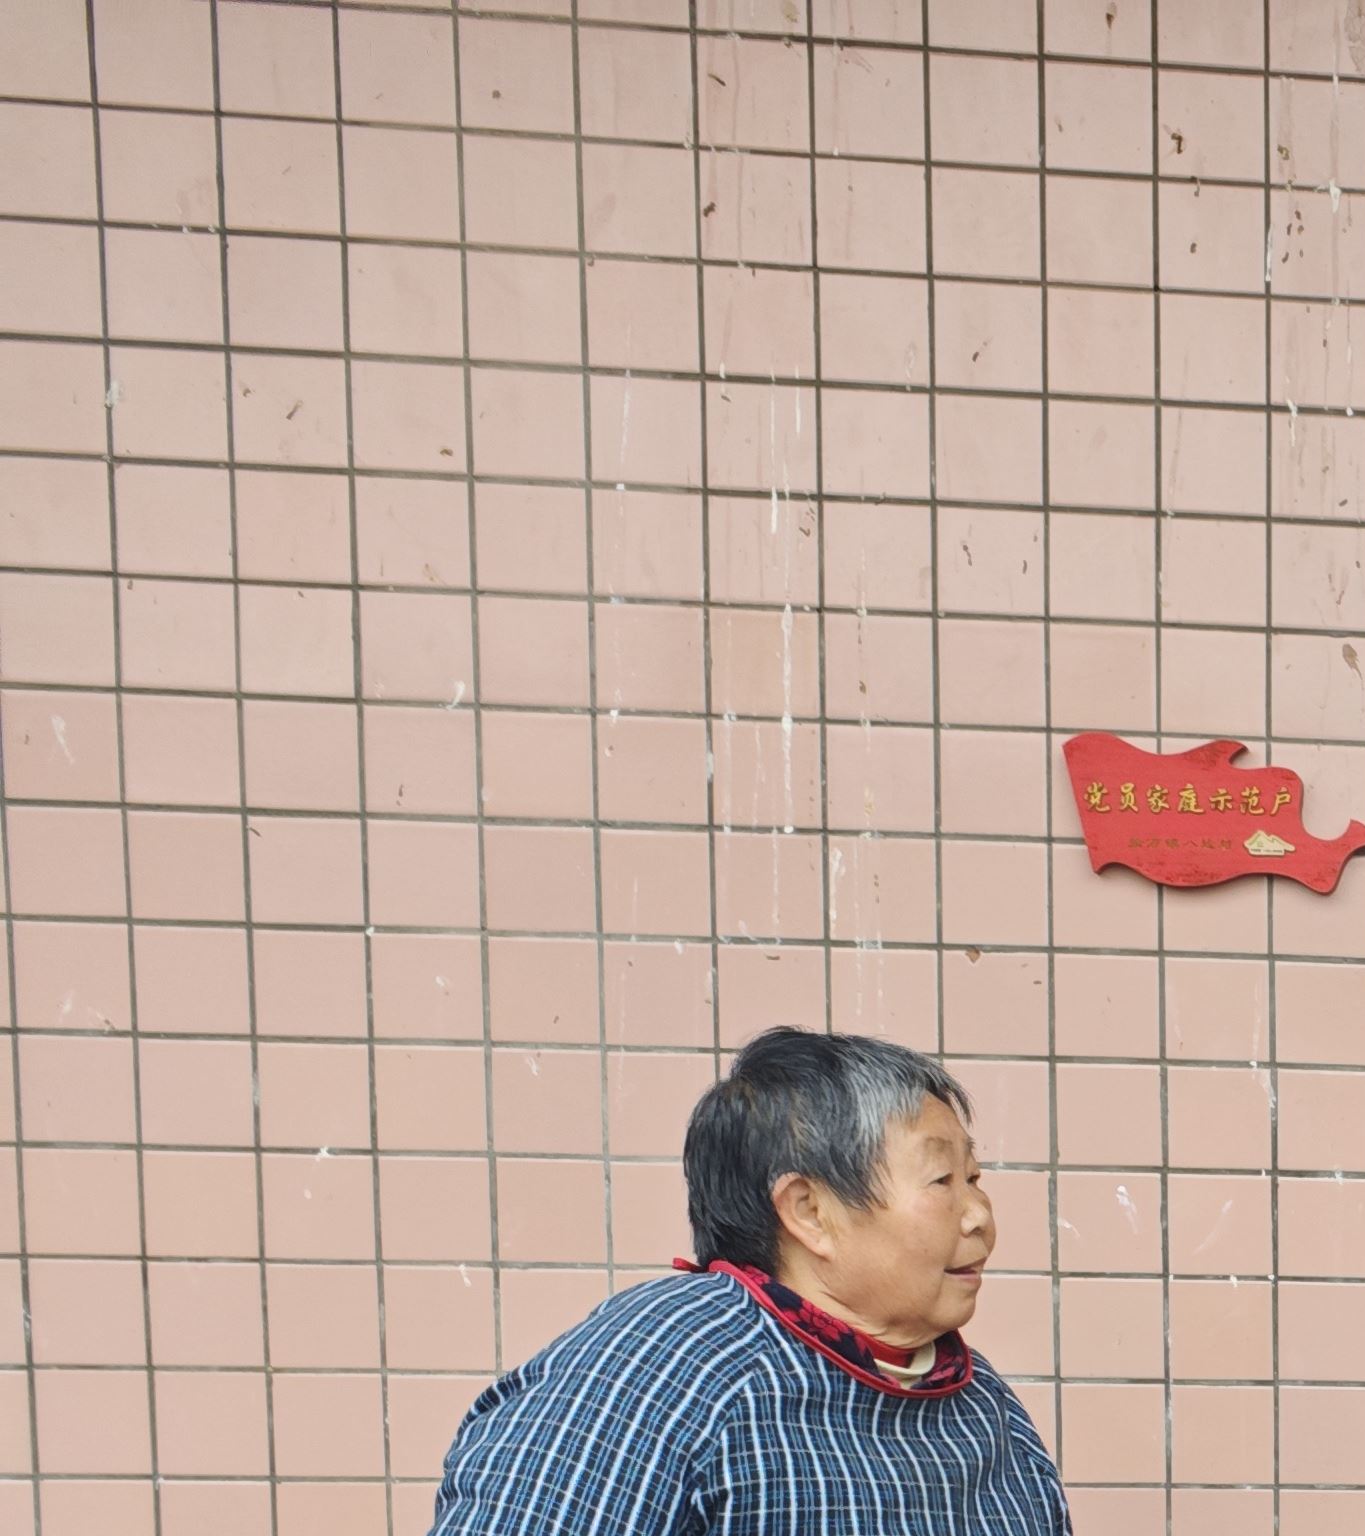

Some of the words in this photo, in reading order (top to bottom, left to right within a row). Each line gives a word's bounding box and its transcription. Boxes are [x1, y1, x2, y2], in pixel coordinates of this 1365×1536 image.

[1084, 781, 1292, 815] 党员家庭示范户
